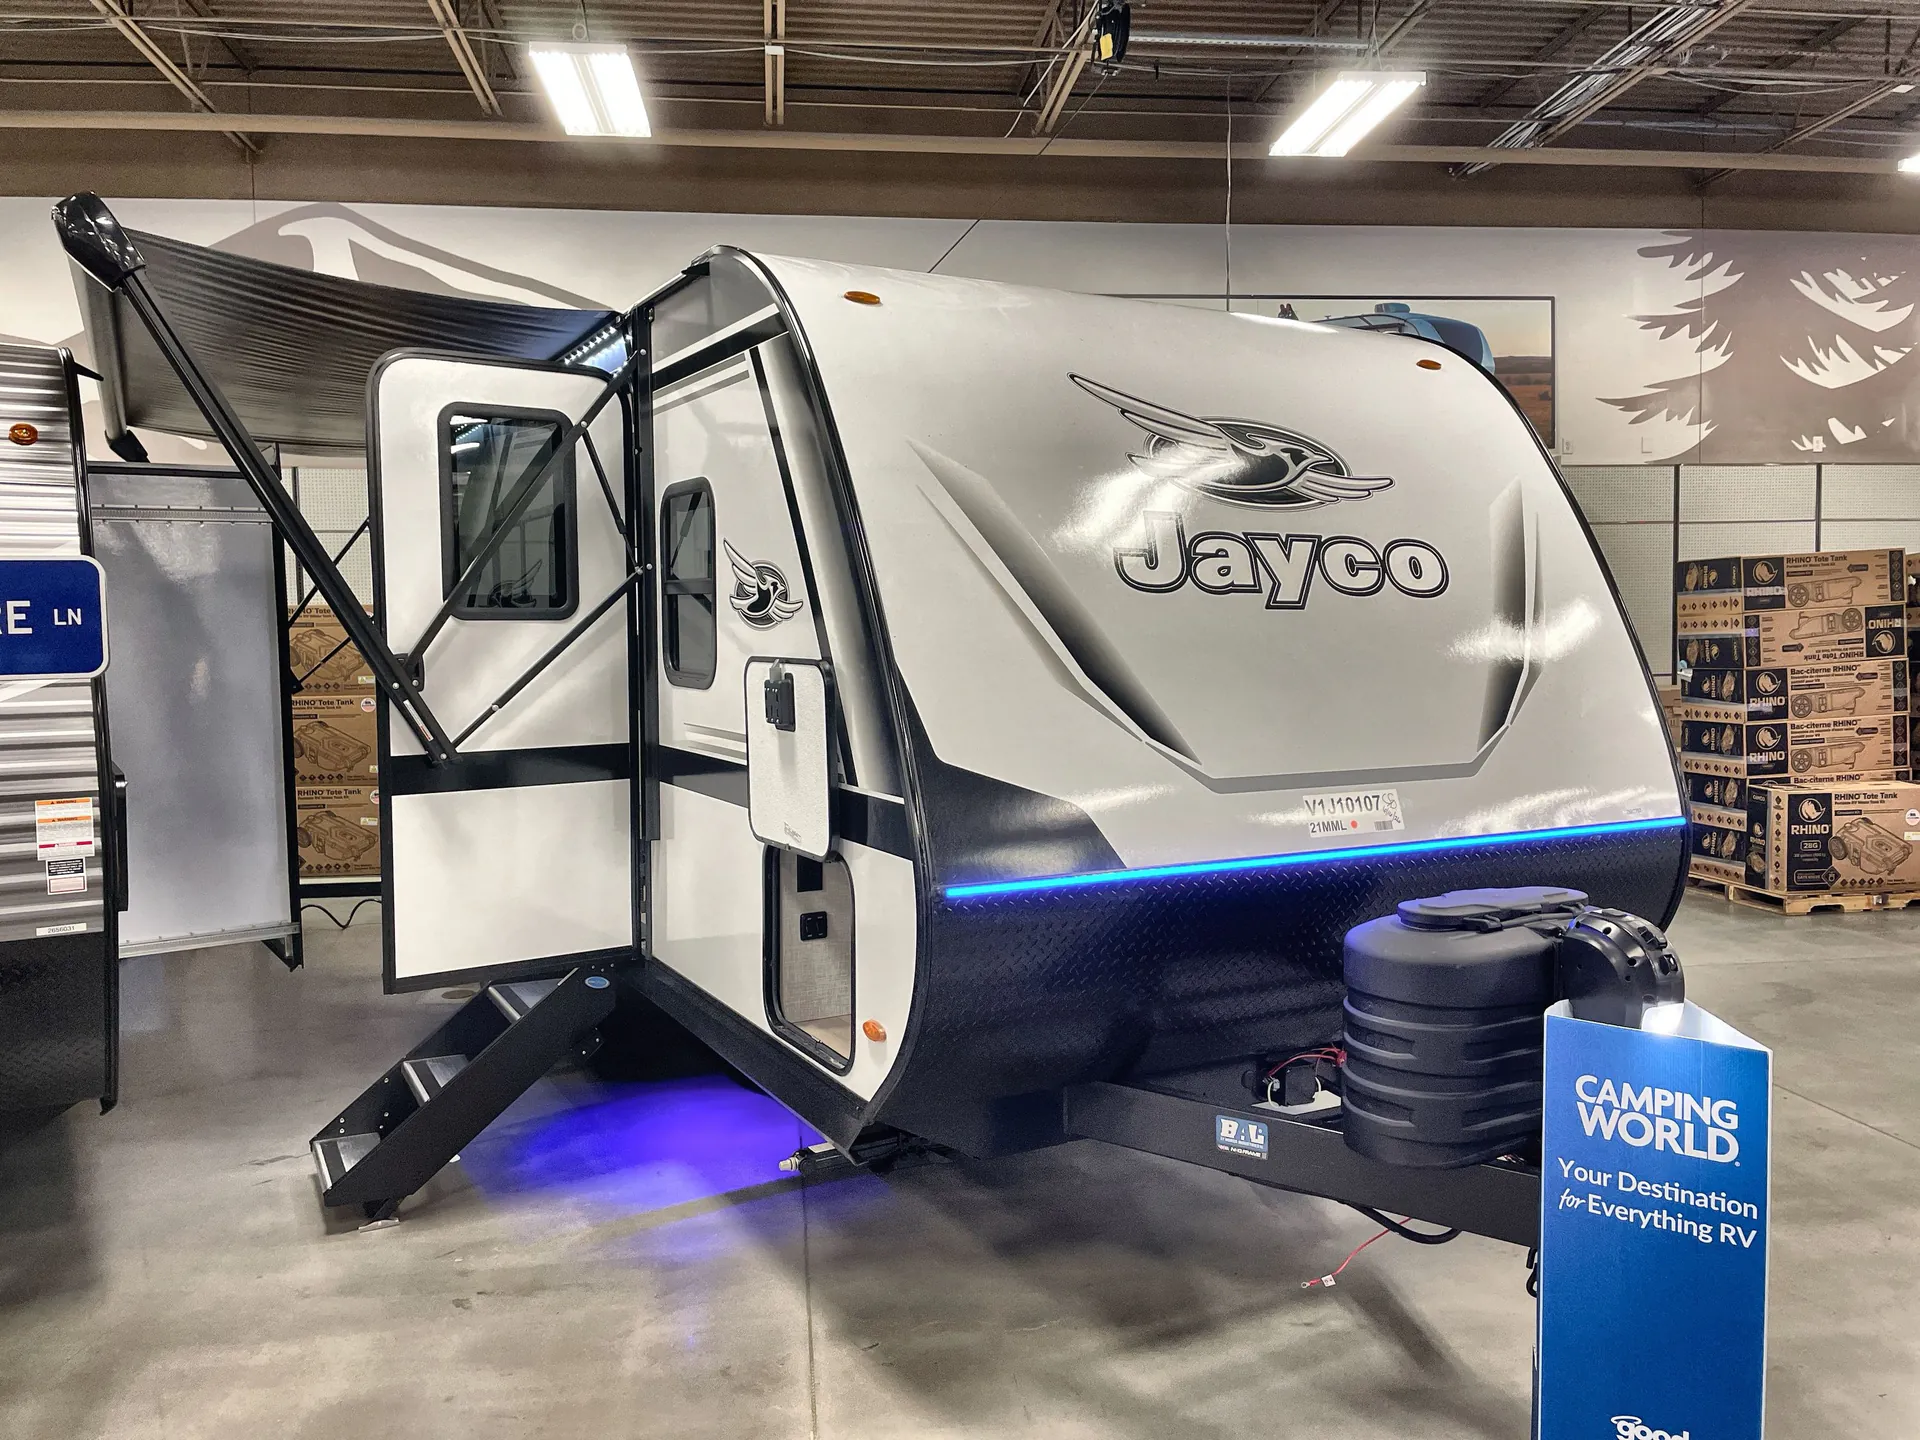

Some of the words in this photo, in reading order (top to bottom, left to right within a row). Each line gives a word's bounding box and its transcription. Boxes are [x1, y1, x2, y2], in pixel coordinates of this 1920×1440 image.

[1113, 510, 1450, 610] Jayco
[0, 600, 33, 635] E
[53, 608, 82, 626] LN
[1749, 751, 1786, 762] RHINO
[1305, 794, 1380, 816] V1J10107
[1834, 793, 1861, 801] RHINO
[1863, 792, 1878, 800] Tote
[1310, 820, 1348, 833] 21MML
[1791, 824, 1829, 835] RHINO
[1575, 1074, 1739, 1130] CAMPING
[1576, 1101, 1740, 1164] WORLD
[1557, 1157, 1613, 1188] Your
[1618, 1171, 1758, 1220] Destination
[1558, 1187, 1587, 1211] for
[1588, 1193, 1713, 1244] Everything
[1720, 1223, 1758, 1249] RV
